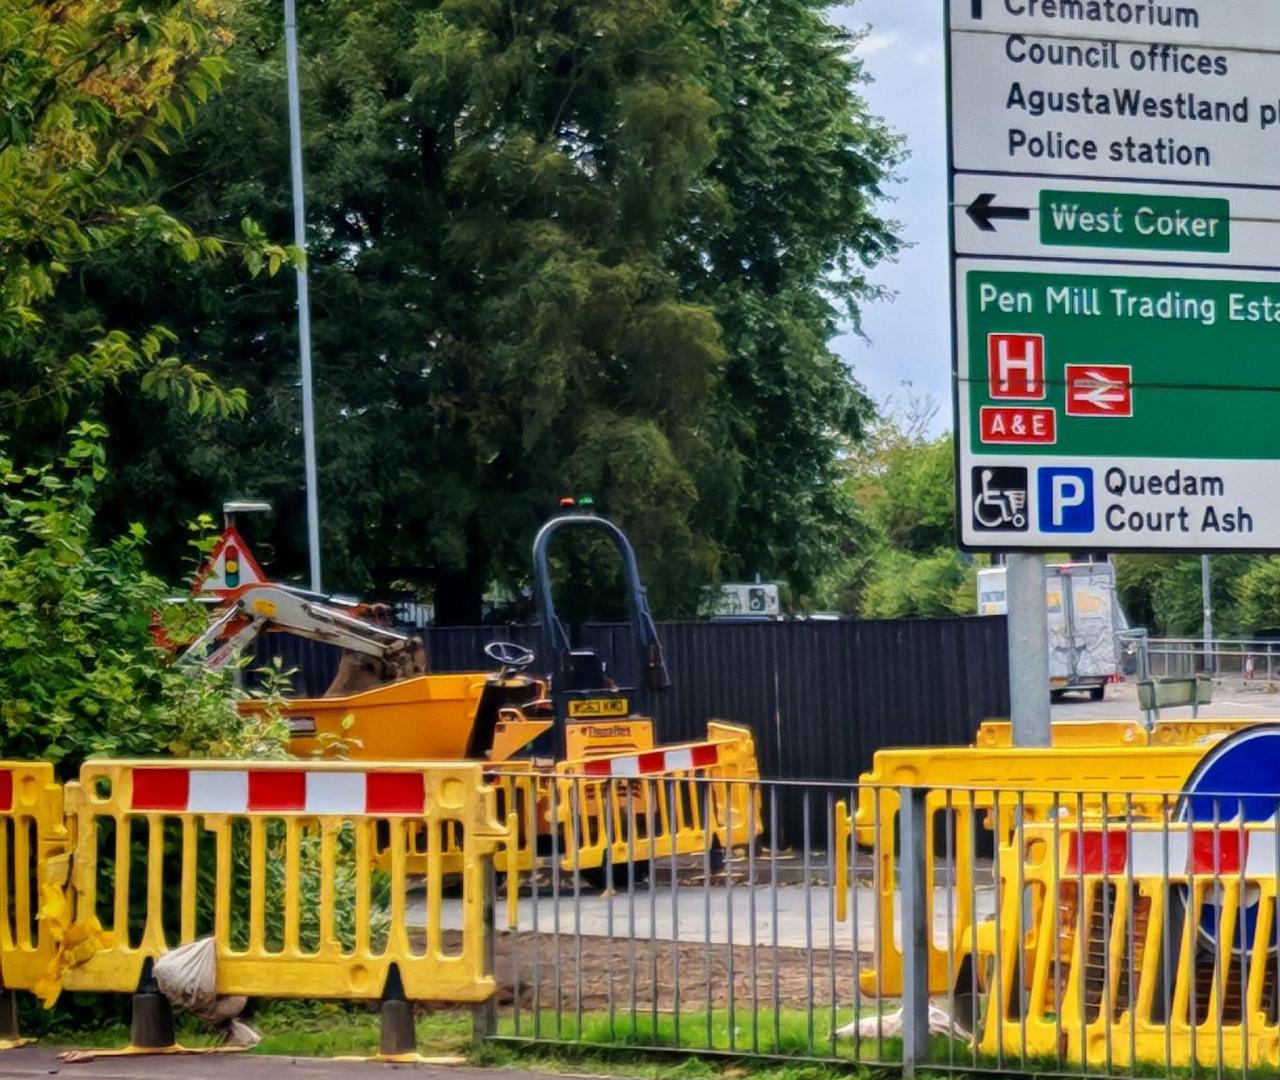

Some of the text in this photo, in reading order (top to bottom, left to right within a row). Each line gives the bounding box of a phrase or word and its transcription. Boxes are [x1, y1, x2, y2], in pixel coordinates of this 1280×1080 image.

[1005, 0, 1199, 28] Crematorium
[1005, 35, 1228, 77] Council offices
[1006, 82, 1248, 124] AgustaWestland
[1008, 129, 1210, 167] Police station
[1052, 204, 1220, 238] West Coker
[980, 283, 1032, 314] Pen
[1047, 286, 1101, 317] Mill
[1110, 289, 1216, 326] Trading
[998, 339, 1036, 393] H
[1052, 475, 1086, 527] P
[1104, 466, 1225, 498] Quedam
[1105, 504, 1254, 534] Court Ash
